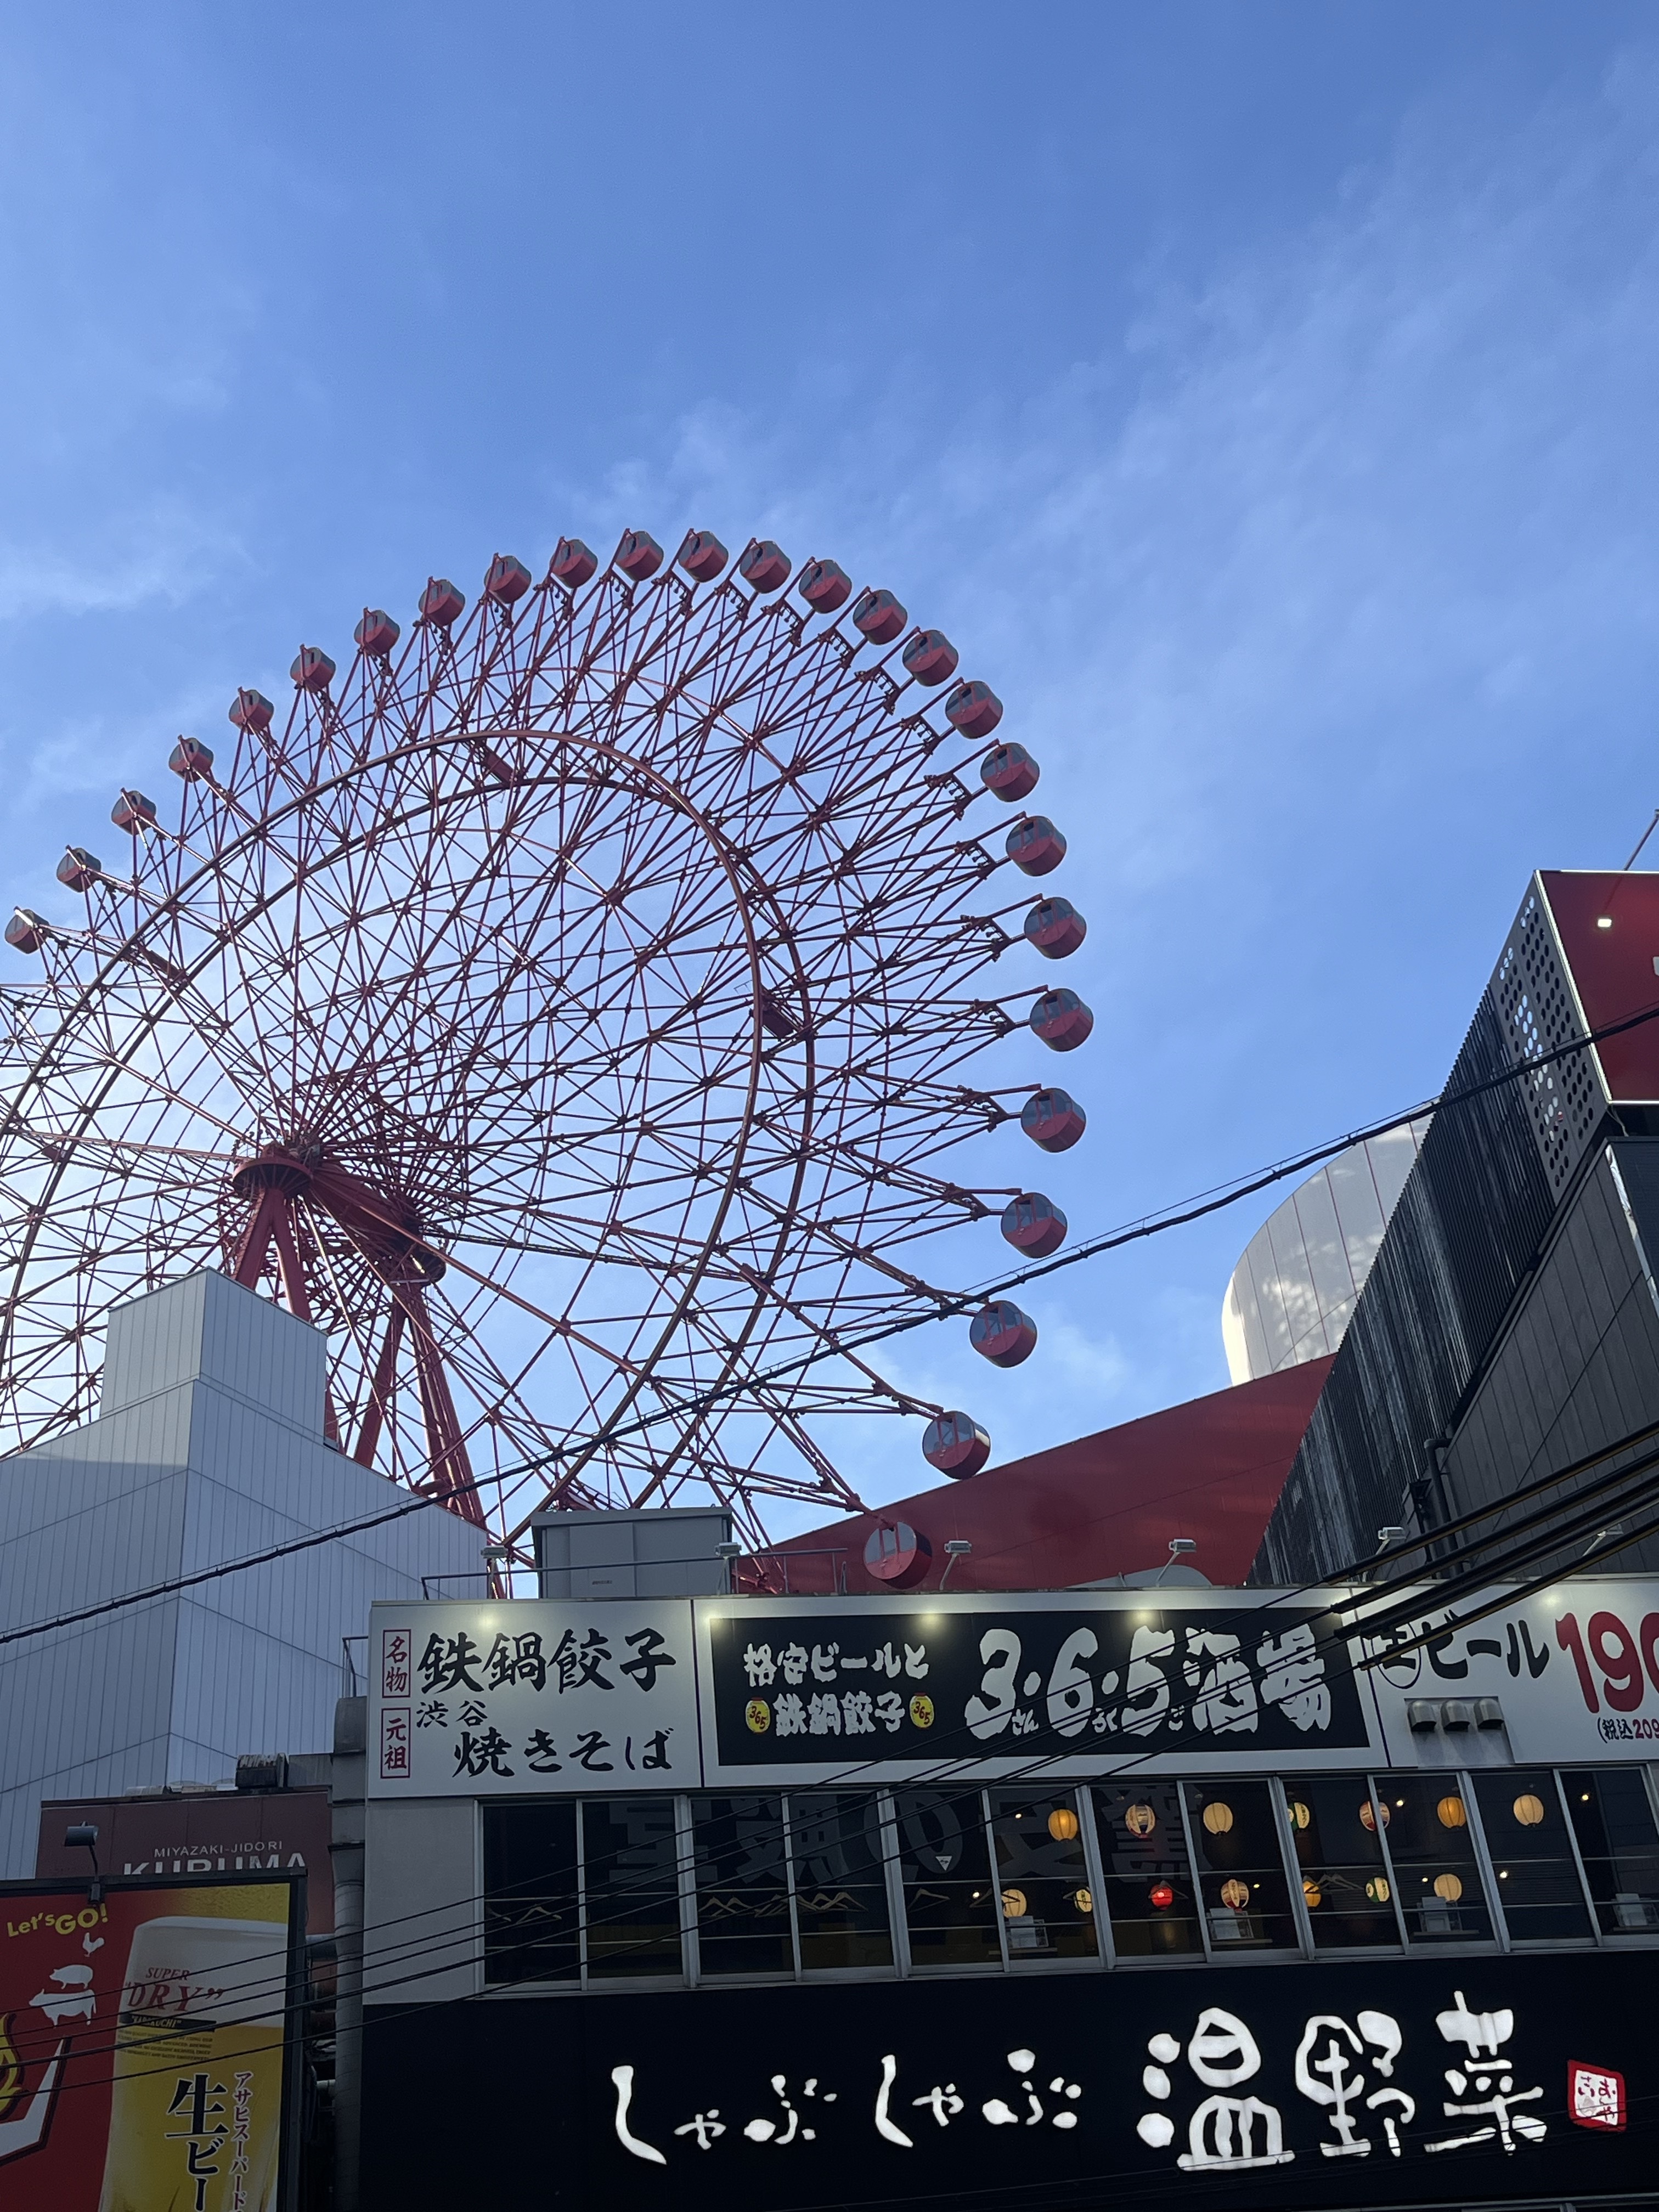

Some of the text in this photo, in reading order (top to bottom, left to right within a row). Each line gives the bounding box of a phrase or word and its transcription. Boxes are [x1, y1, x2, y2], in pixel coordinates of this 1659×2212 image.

[385, 1635, 408, 1693] 名物
[417, 1627, 676, 1695] 鉄鍋餃子
[743, 1641, 929, 1687] 格安ビールと
[416, 1700, 488, 1728] 渋谷
[749, 1706, 766, 1730] 365
[773, 1690, 905, 1737] 鉄鍋餃子
[913, 1701, 930, 1725] 365
[385, 1718, 408, 1770] 元祖
[453, 1726, 674, 1778] 焼きそば
[154, 1841, 283, 1858] MIYAZAKI-JIDORI
[7, 1903, 108, 1938] Let's GO!
[145, 1967, 190, 1981] SUPER
[166, 2074, 229, 2211] 生ビー
[230, 2072, 252, 2212] アサヒスーパード
